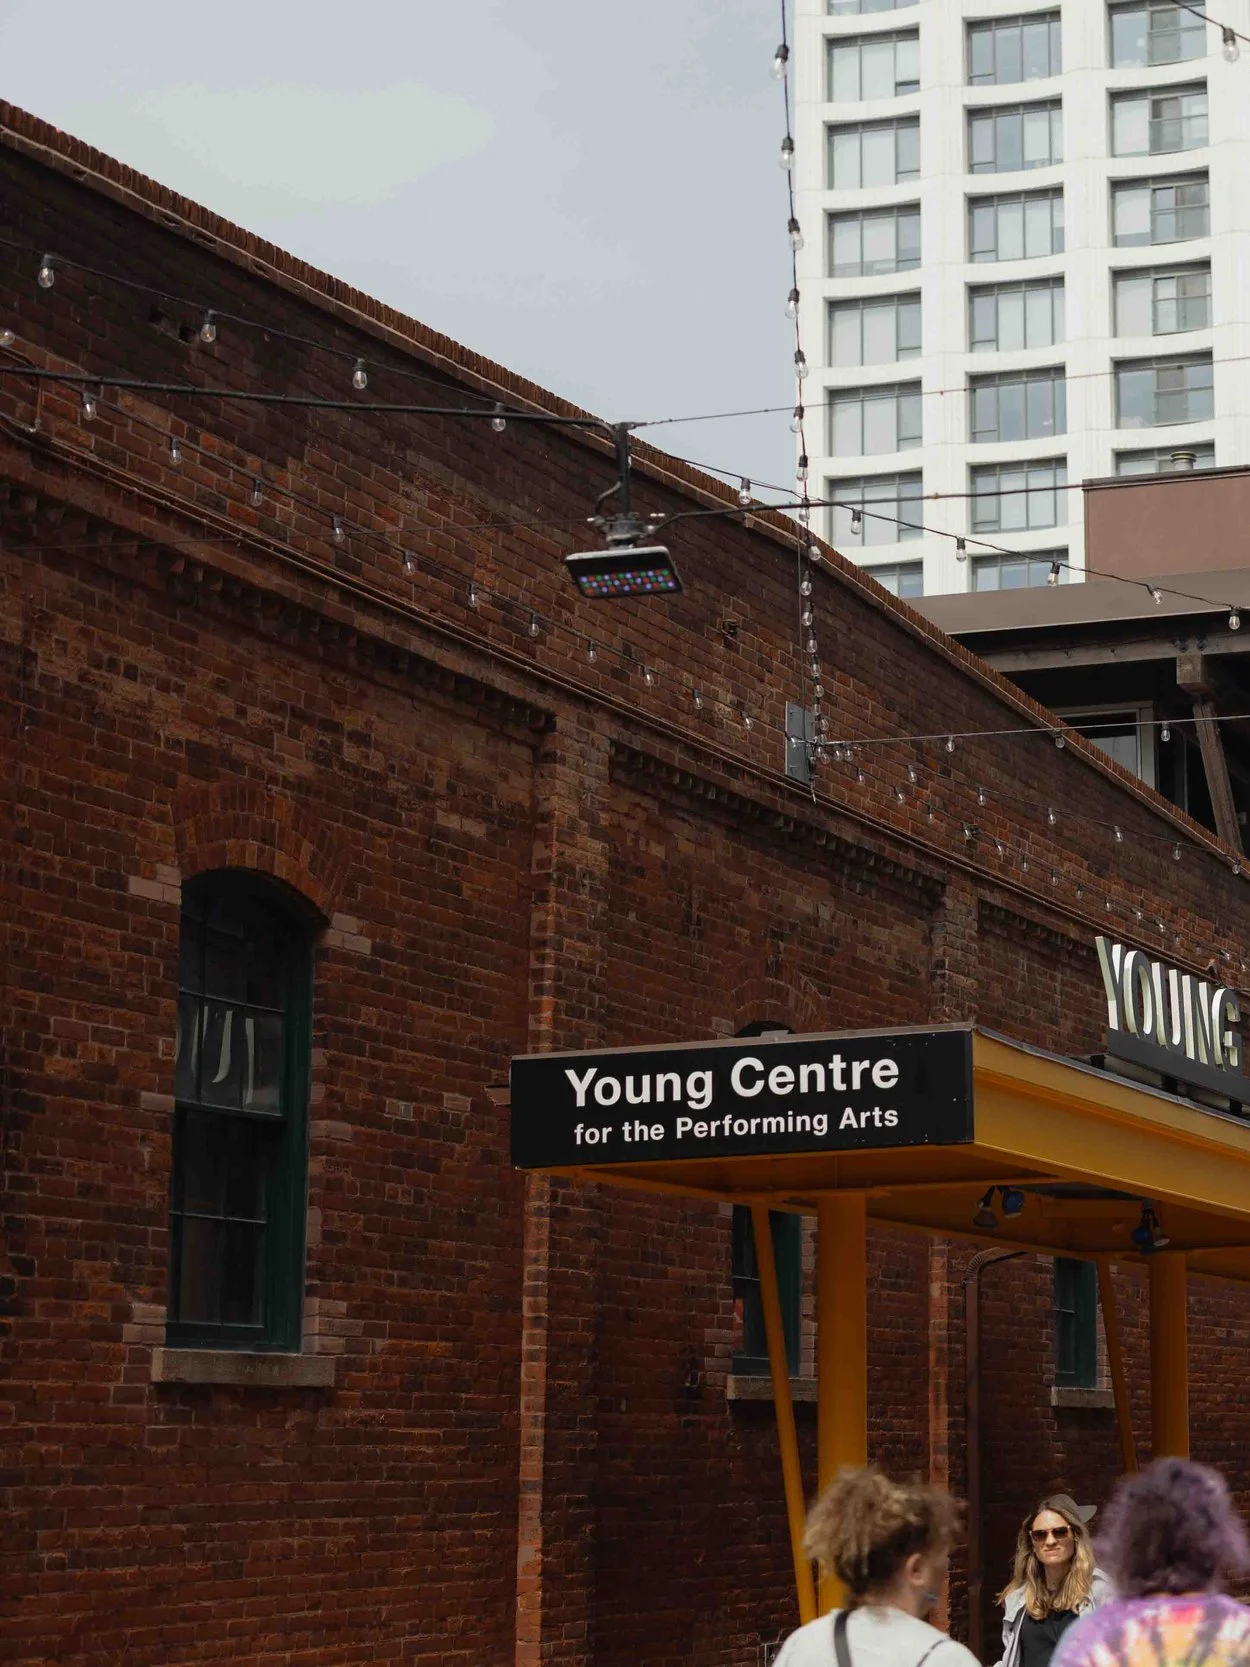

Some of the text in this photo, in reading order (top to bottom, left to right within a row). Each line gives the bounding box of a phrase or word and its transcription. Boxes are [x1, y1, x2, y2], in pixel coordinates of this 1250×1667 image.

[1095, 936, 1243, 1075] YOUNG
[565, 1053, 899, 1110] Young Centre
[573, 1106, 899, 1145] for the Performing Arts
